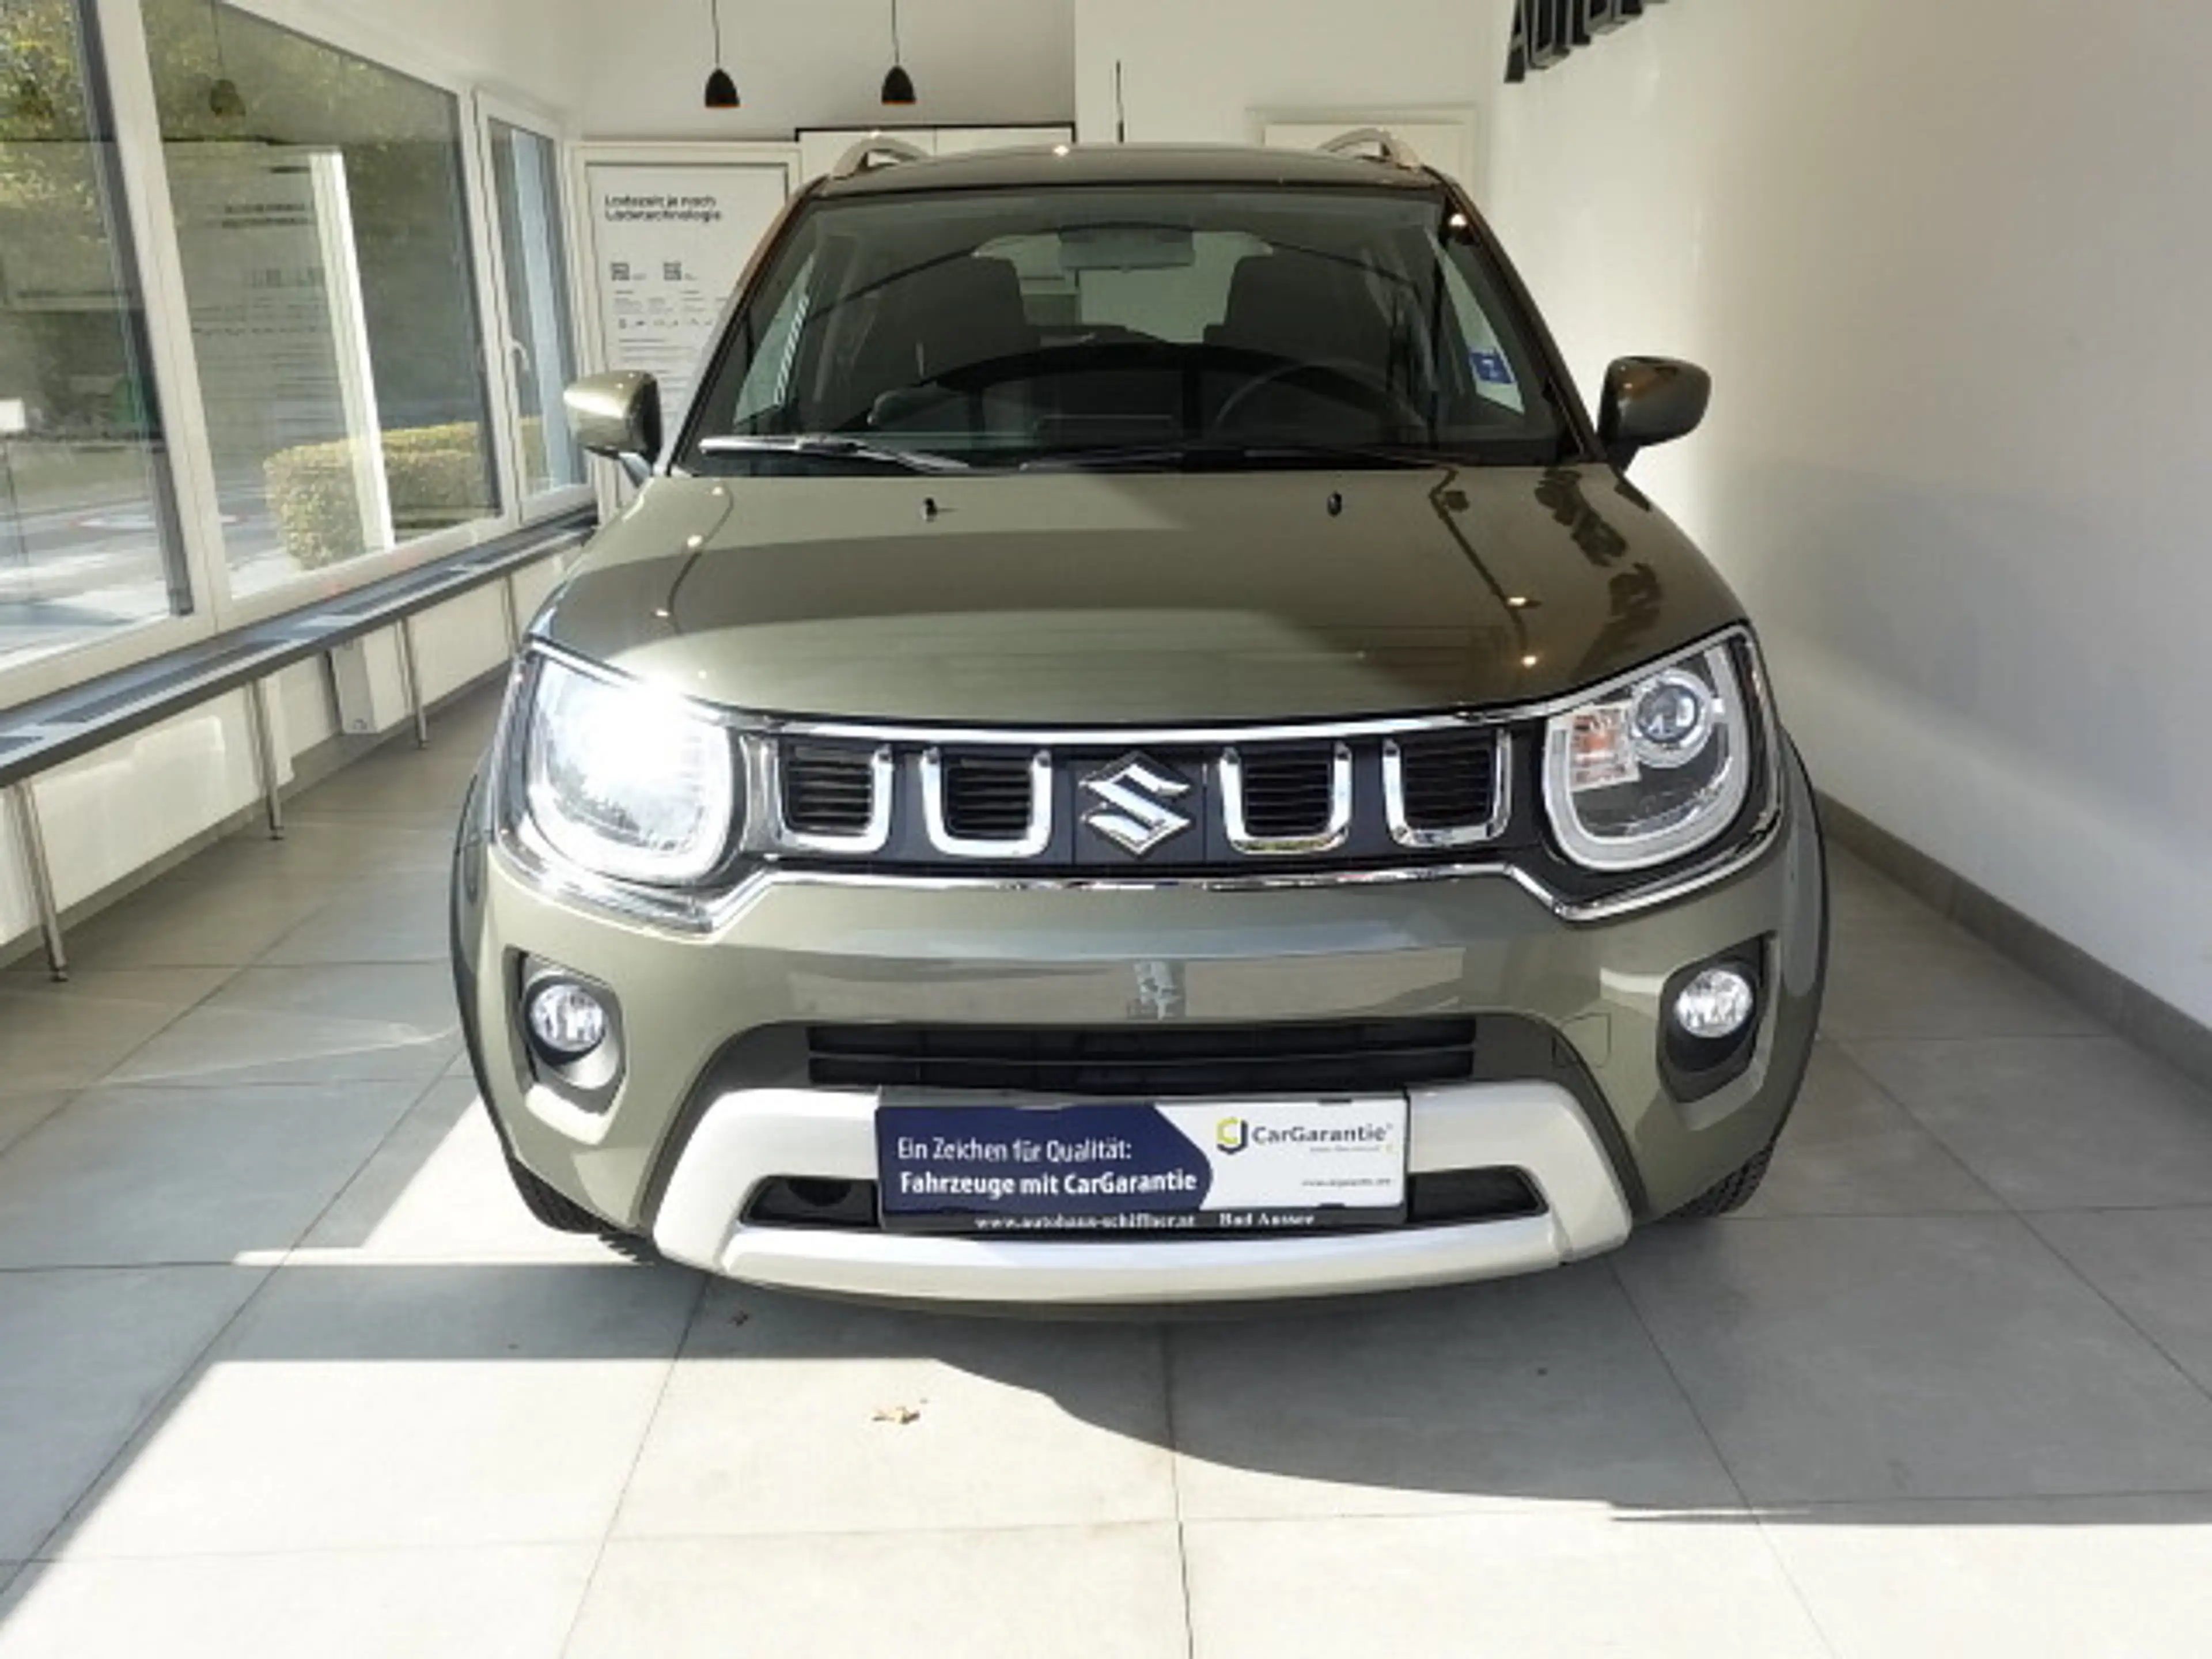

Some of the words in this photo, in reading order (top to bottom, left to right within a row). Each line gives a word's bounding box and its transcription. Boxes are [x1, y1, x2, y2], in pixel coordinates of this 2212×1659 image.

[897, 1137, 927, 1160] Ein
[932, 1137, 1007, 1162] Zeichen
[1012, 1139, 1041, 1162] für
[1046, 1138, 1132, 1163] Qualität:
[900, 1172, 1016, 1200] Fahrzeuge
[1020, 1172, 1059, 1195] mit
[1063, 1168, 1198, 1195] CarGarantie
